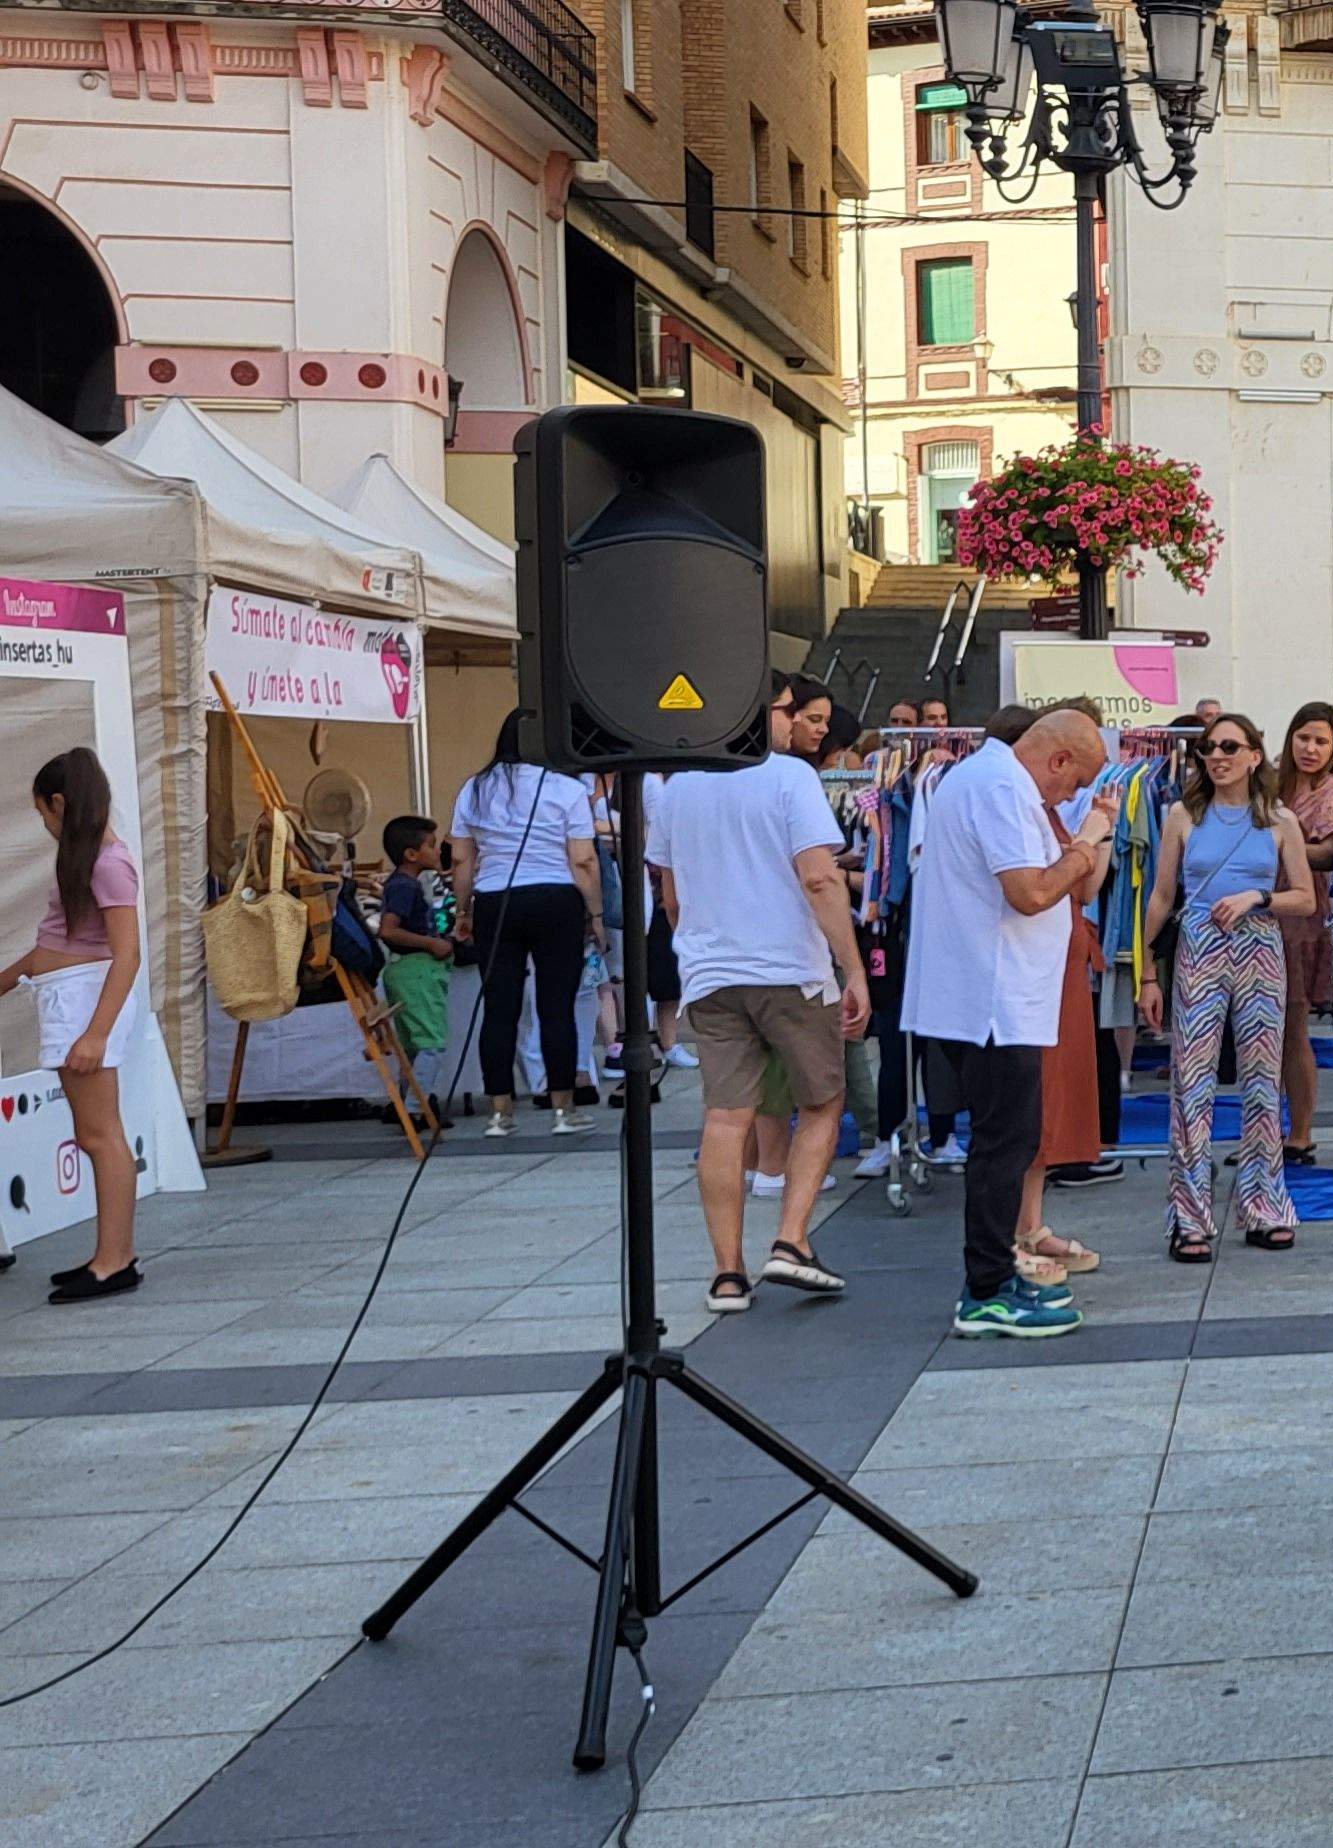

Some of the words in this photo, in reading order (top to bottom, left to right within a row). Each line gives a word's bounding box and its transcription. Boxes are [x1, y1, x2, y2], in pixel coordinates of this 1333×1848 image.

[95, 567, 161, 577] MASTERTENT
[231, 595, 285, 640] Súmate
[290, 608, 302, 644] al
[247, 671, 257, 708] y
[310, 677, 321, 704] a
[324, 671, 342, 706] la
